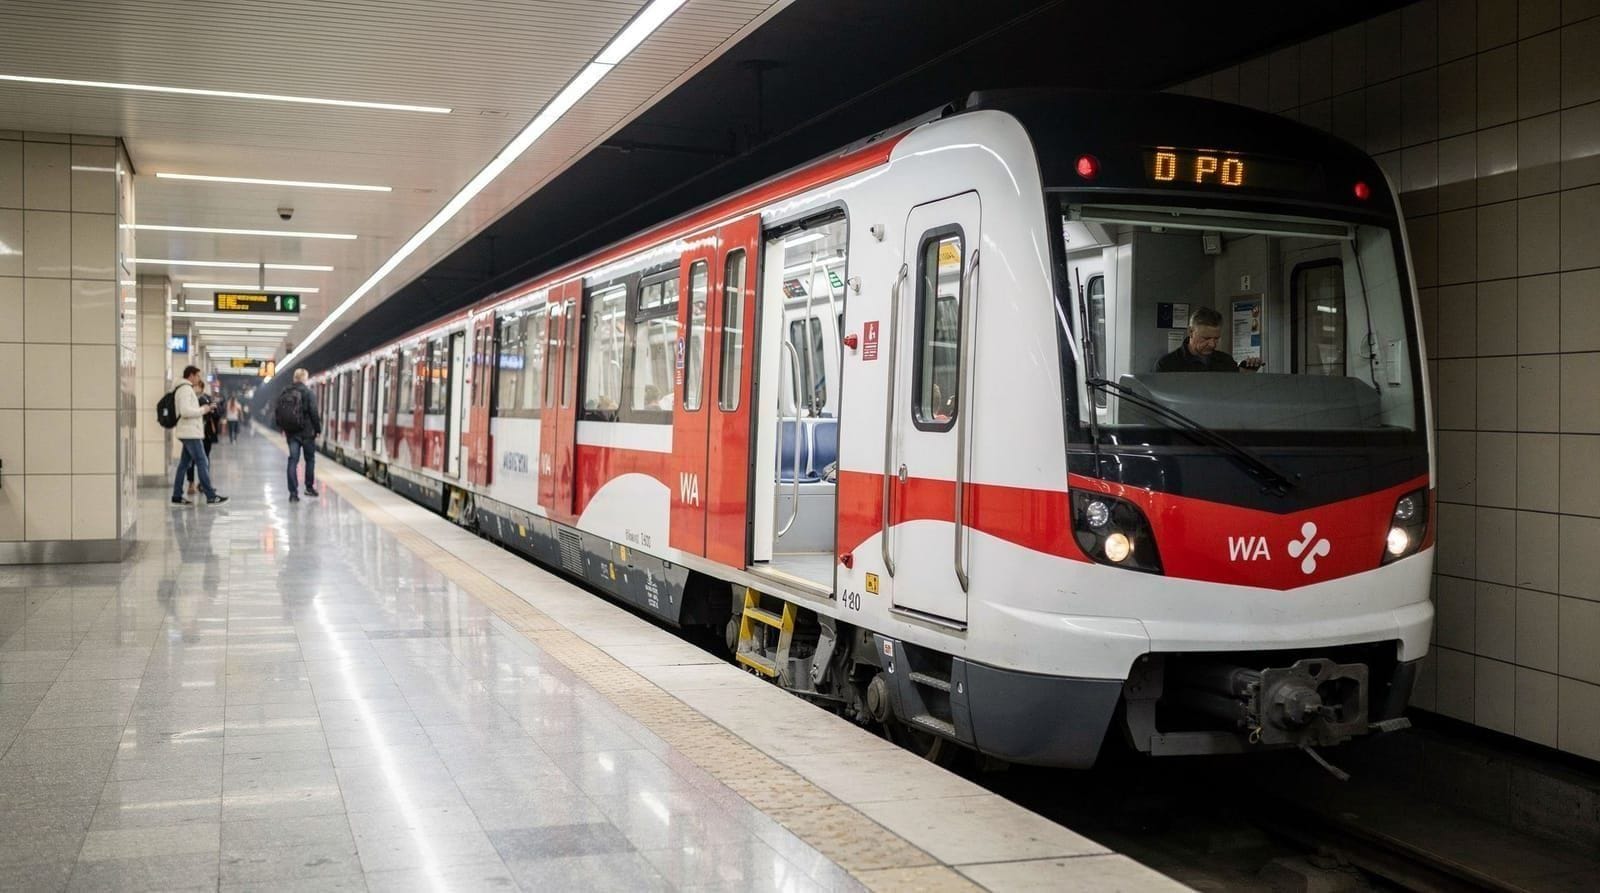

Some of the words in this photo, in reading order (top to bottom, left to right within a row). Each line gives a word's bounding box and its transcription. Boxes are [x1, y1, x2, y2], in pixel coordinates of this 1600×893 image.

[1154, 152, 1176, 181] D
[274, 295, 282, 311] 1
[680, 471, 699, 507] WA
[1228, 536, 1271, 561] WA
